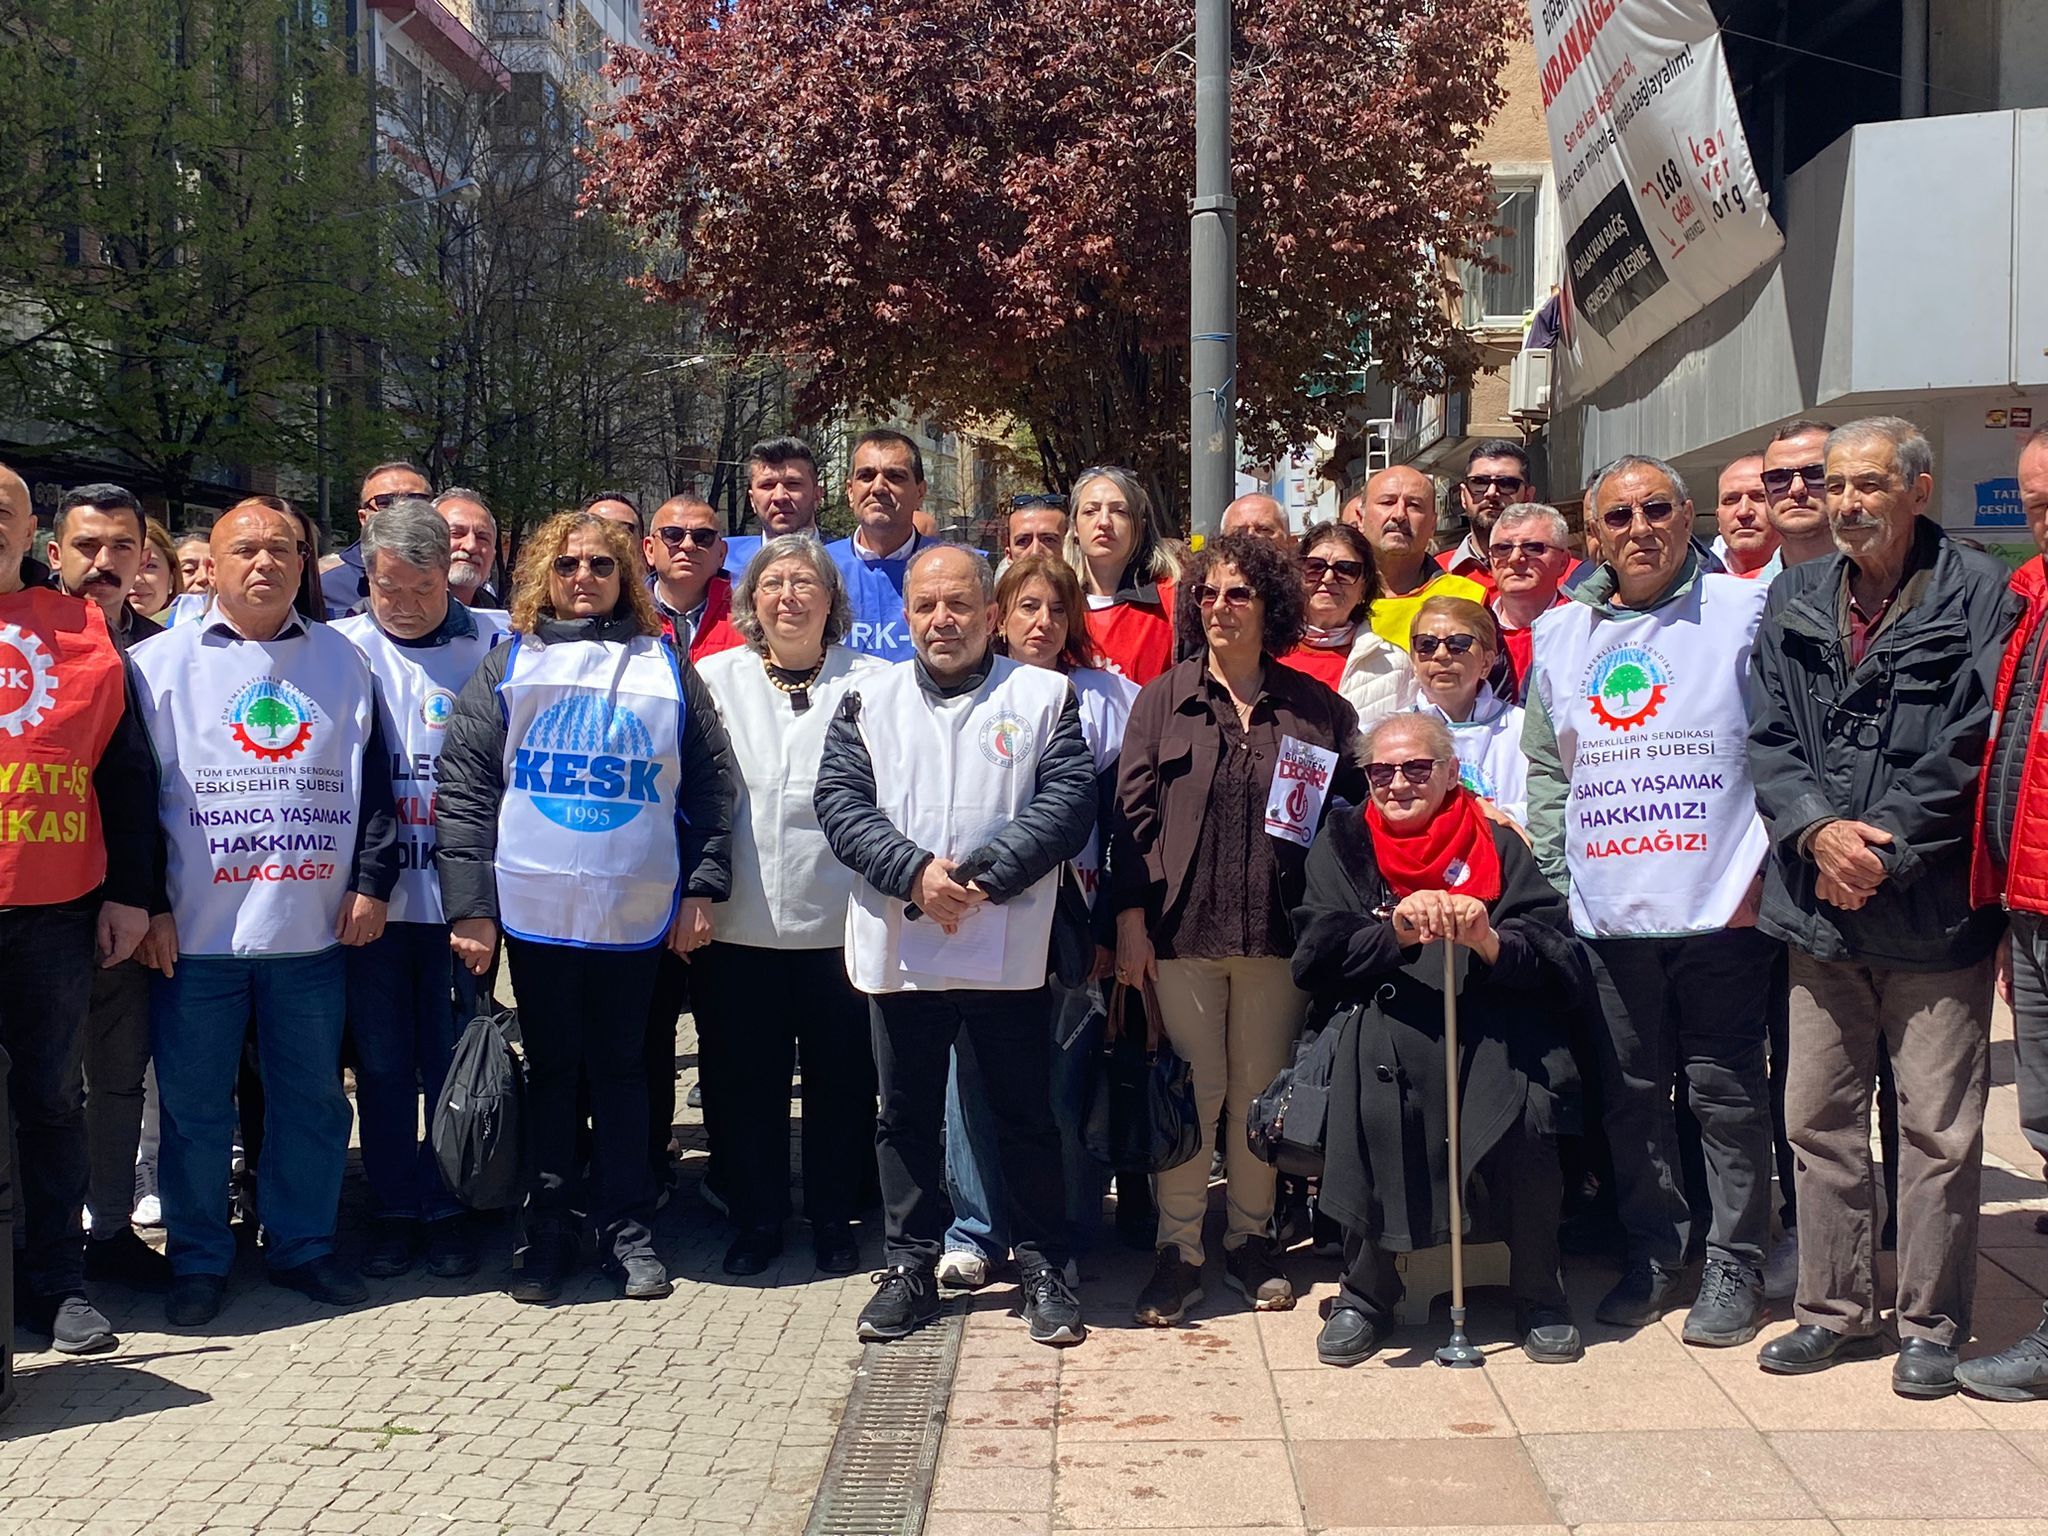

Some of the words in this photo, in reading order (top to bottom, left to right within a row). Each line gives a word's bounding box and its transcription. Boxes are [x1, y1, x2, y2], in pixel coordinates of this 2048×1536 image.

[1701, 157, 1730, 193] ver
[840, 621, 914, 650] RK-
[1651, 728, 1714, 741] SENDİKASI
[1574, 747, 1641, 767] KİŞEHİR
[1646, 740, 1715, 761] ŞUBESİ
[196, 768, 222, 778] TÜM
[226, 765, 297, 777] EMEKLİLERİN
[299, 766, 344, 778] SENDİKASI
[513, 747, 663, 804] KESK
[195, 777, 290, 795] ESKİŞEHİR
[296, 779, 345, 794] ŞUBESİ
[1631, 773, 1724, 794] YAŞAMAK
[189, 807, 275, 827] İNSANCA
[280, 807, 352, 827] YAŞAMAK
[564, 805, 611, 826] 1995
[1580, 801, 1707, 829] HAKKIMIZ!
[209, 834, 338, 855] HAKKIMIZ!
[1586, 828, 1708, 859] ALACAĞIZ!
[212, 858, 335, 884] ALACAĞIZ!
